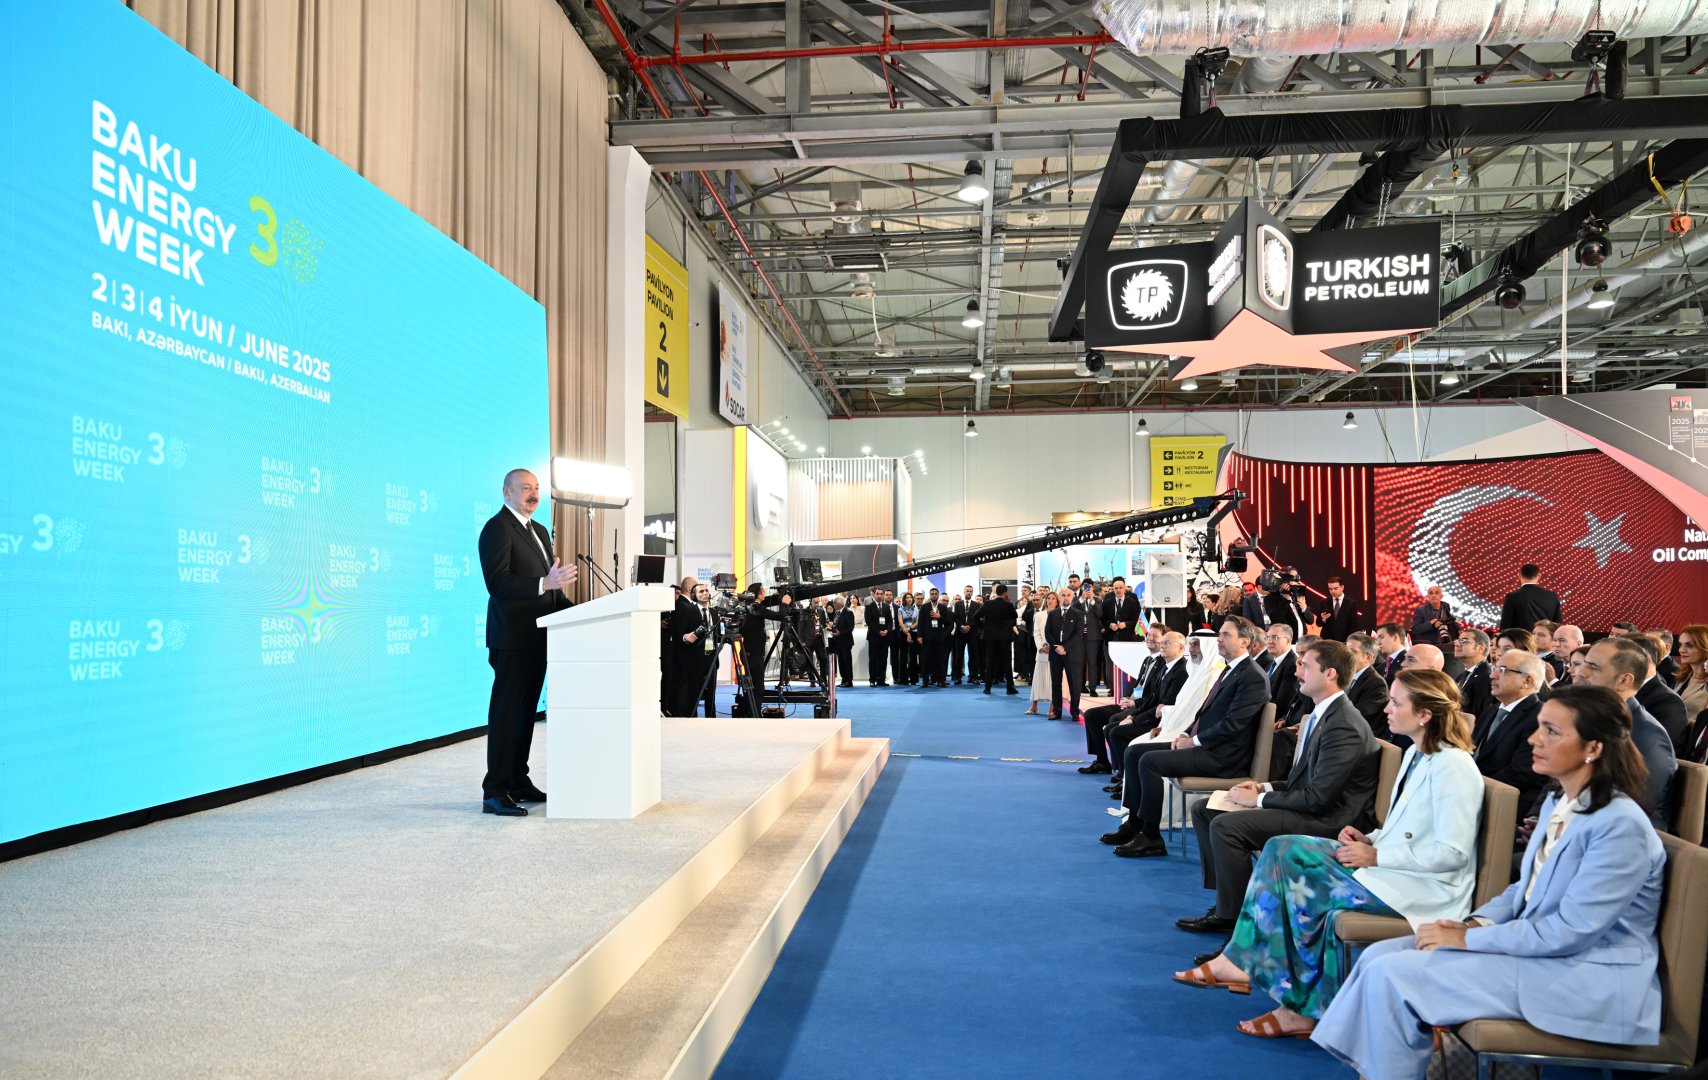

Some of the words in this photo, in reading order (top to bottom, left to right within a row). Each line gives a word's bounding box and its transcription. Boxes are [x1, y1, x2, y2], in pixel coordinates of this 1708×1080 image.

[93, 100, 196, 191] BAKU
[92, 150, 236, 255] ENERGY
[92, 200, 204, 286] WEEK
[1305, 253, 1431, 284] TURKISH
[1136, 286, 1159, 303] TP
[1304, 278, 1430, 302] PETROLEUM
[647, 289, 673, 320] PAVILION
[170, 295, 223, 344] İYUN
[240, 332, 289, 368] JUNE
[292, 351, 331, 383] 2025
[659, 321, 667, 352] 2
[92, 311, 132, 342] BAKI,
[136, 327, 225, 370] AZƏRBAYCAN
[234, 360, 268, 385] BAKU,
[270, 374, 331, 404] AZERBAIJAN
[730, 397, 746, 421] SOCAR
[72, 415, 122, 441] BAKU
[72, 437, 142, 465] ENERGY
[1197, 451, 1204, 459] 2
[72, 459, 125, 483] WEEK
[262, 456, 294, 476] BAKU
[261, 474, 307, 494] ENERGY
[386, 483, 409, 497] BAKU
[262, 491, 295, 508] WEEK
[386, 497, 417, 513] ENERGY
[386, 511, 410, 525] WEEK
[178, 528, 217, 547] BAKU
[178, 547, 232, 566] ENERGY
[330, 544, 356, 558] BAKU
[433, 554, 454, 566] BAKU
[1652, 547, 1675, 562] Oil
[1678, 547, 1708, 562] Com
[178, 566, 220, 583] WEEK
[330, 559, 366, 574] ENERGY
[433, 566, 462, 579] ENERGY
[330, 574, 358, 588] WEEK
[433, 579, 454, 591] WEEK
[69, 620, 120, 639] BAKU
[261, 618, 294, 633] BAKU
[386, 615, 409, 627] BAKU
[261, 633, 306, 649] ENERGY
[386, 628, 418, 641] ENERGY
[69, 639, 140, 660] ENERGY
[261, 650, 295, 665] WEEK
[386, 642, 410, 655] WEEK
[69, 660, 123, 682] WEEK
